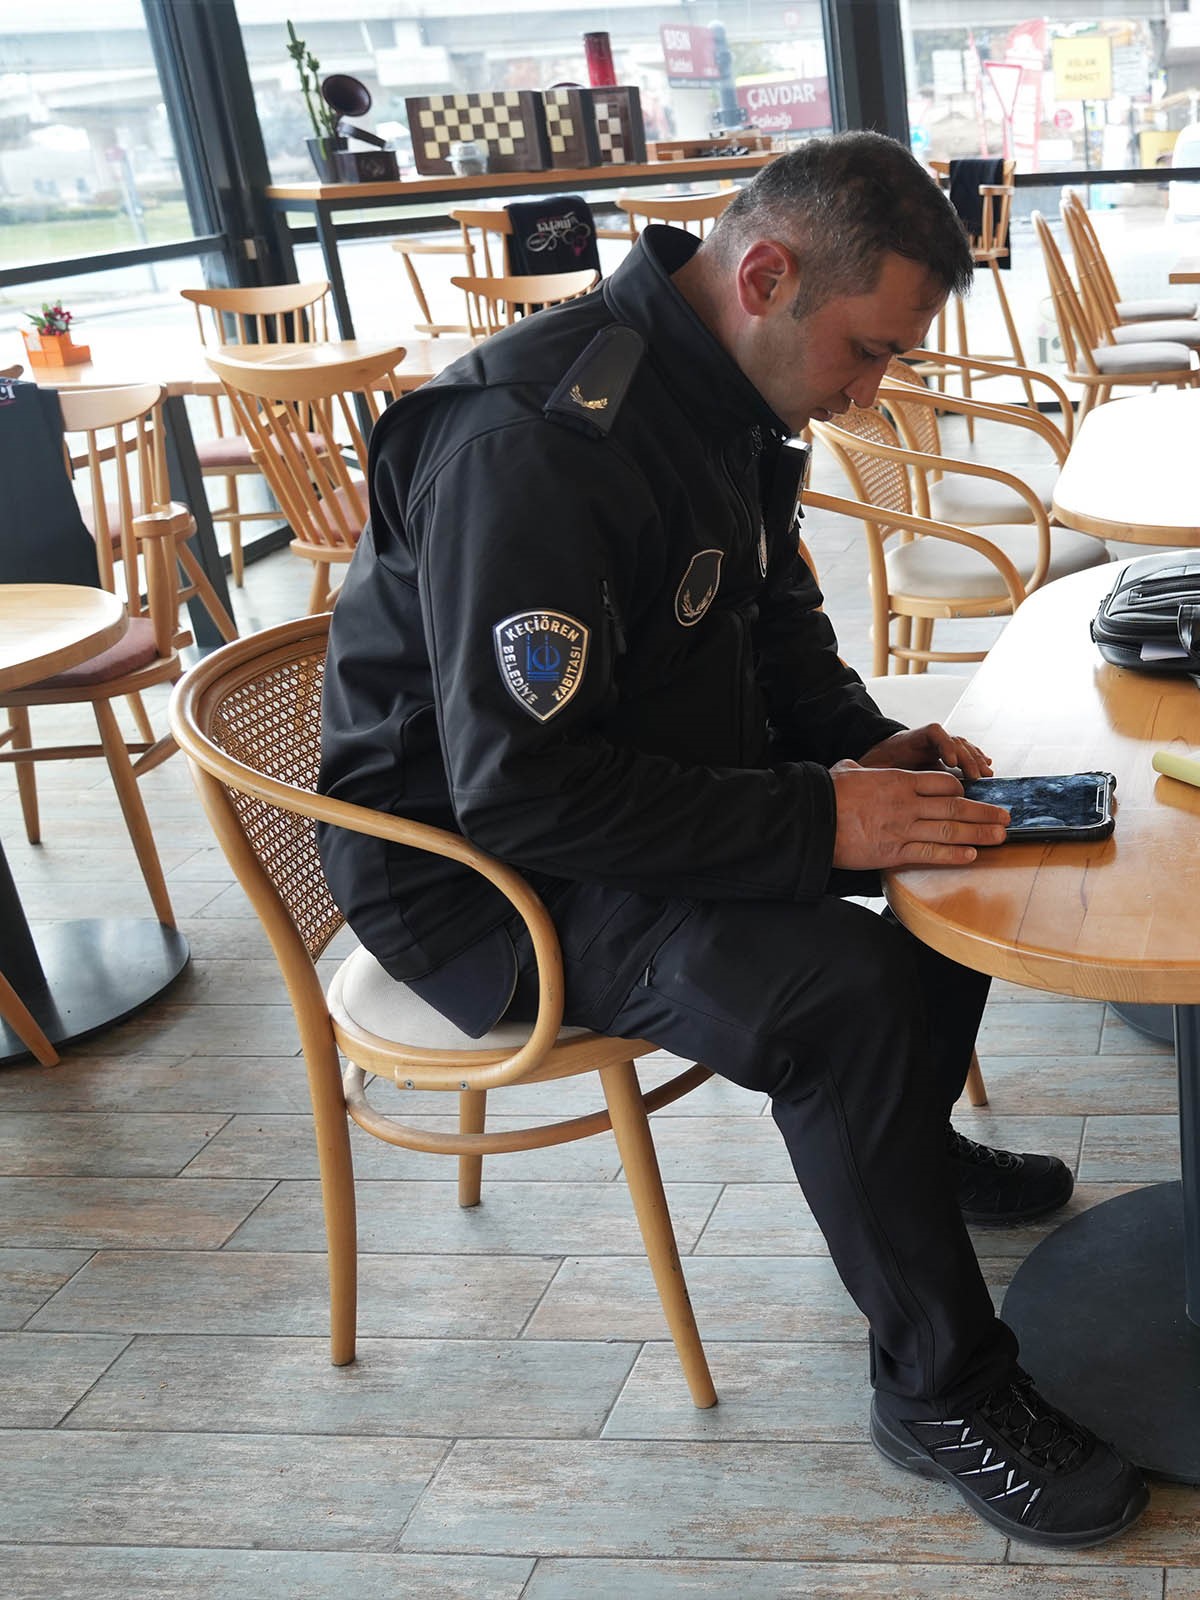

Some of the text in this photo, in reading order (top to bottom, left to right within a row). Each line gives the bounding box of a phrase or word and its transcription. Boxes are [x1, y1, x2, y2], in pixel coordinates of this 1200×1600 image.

[747, 84, 816, 110] ÇAVDAR
[505, 616, 579, 642] KEÇİÖREN
[503, 645, 538, 704] BELEDİYE
[552, 646, 582, 701] ZABITASI
